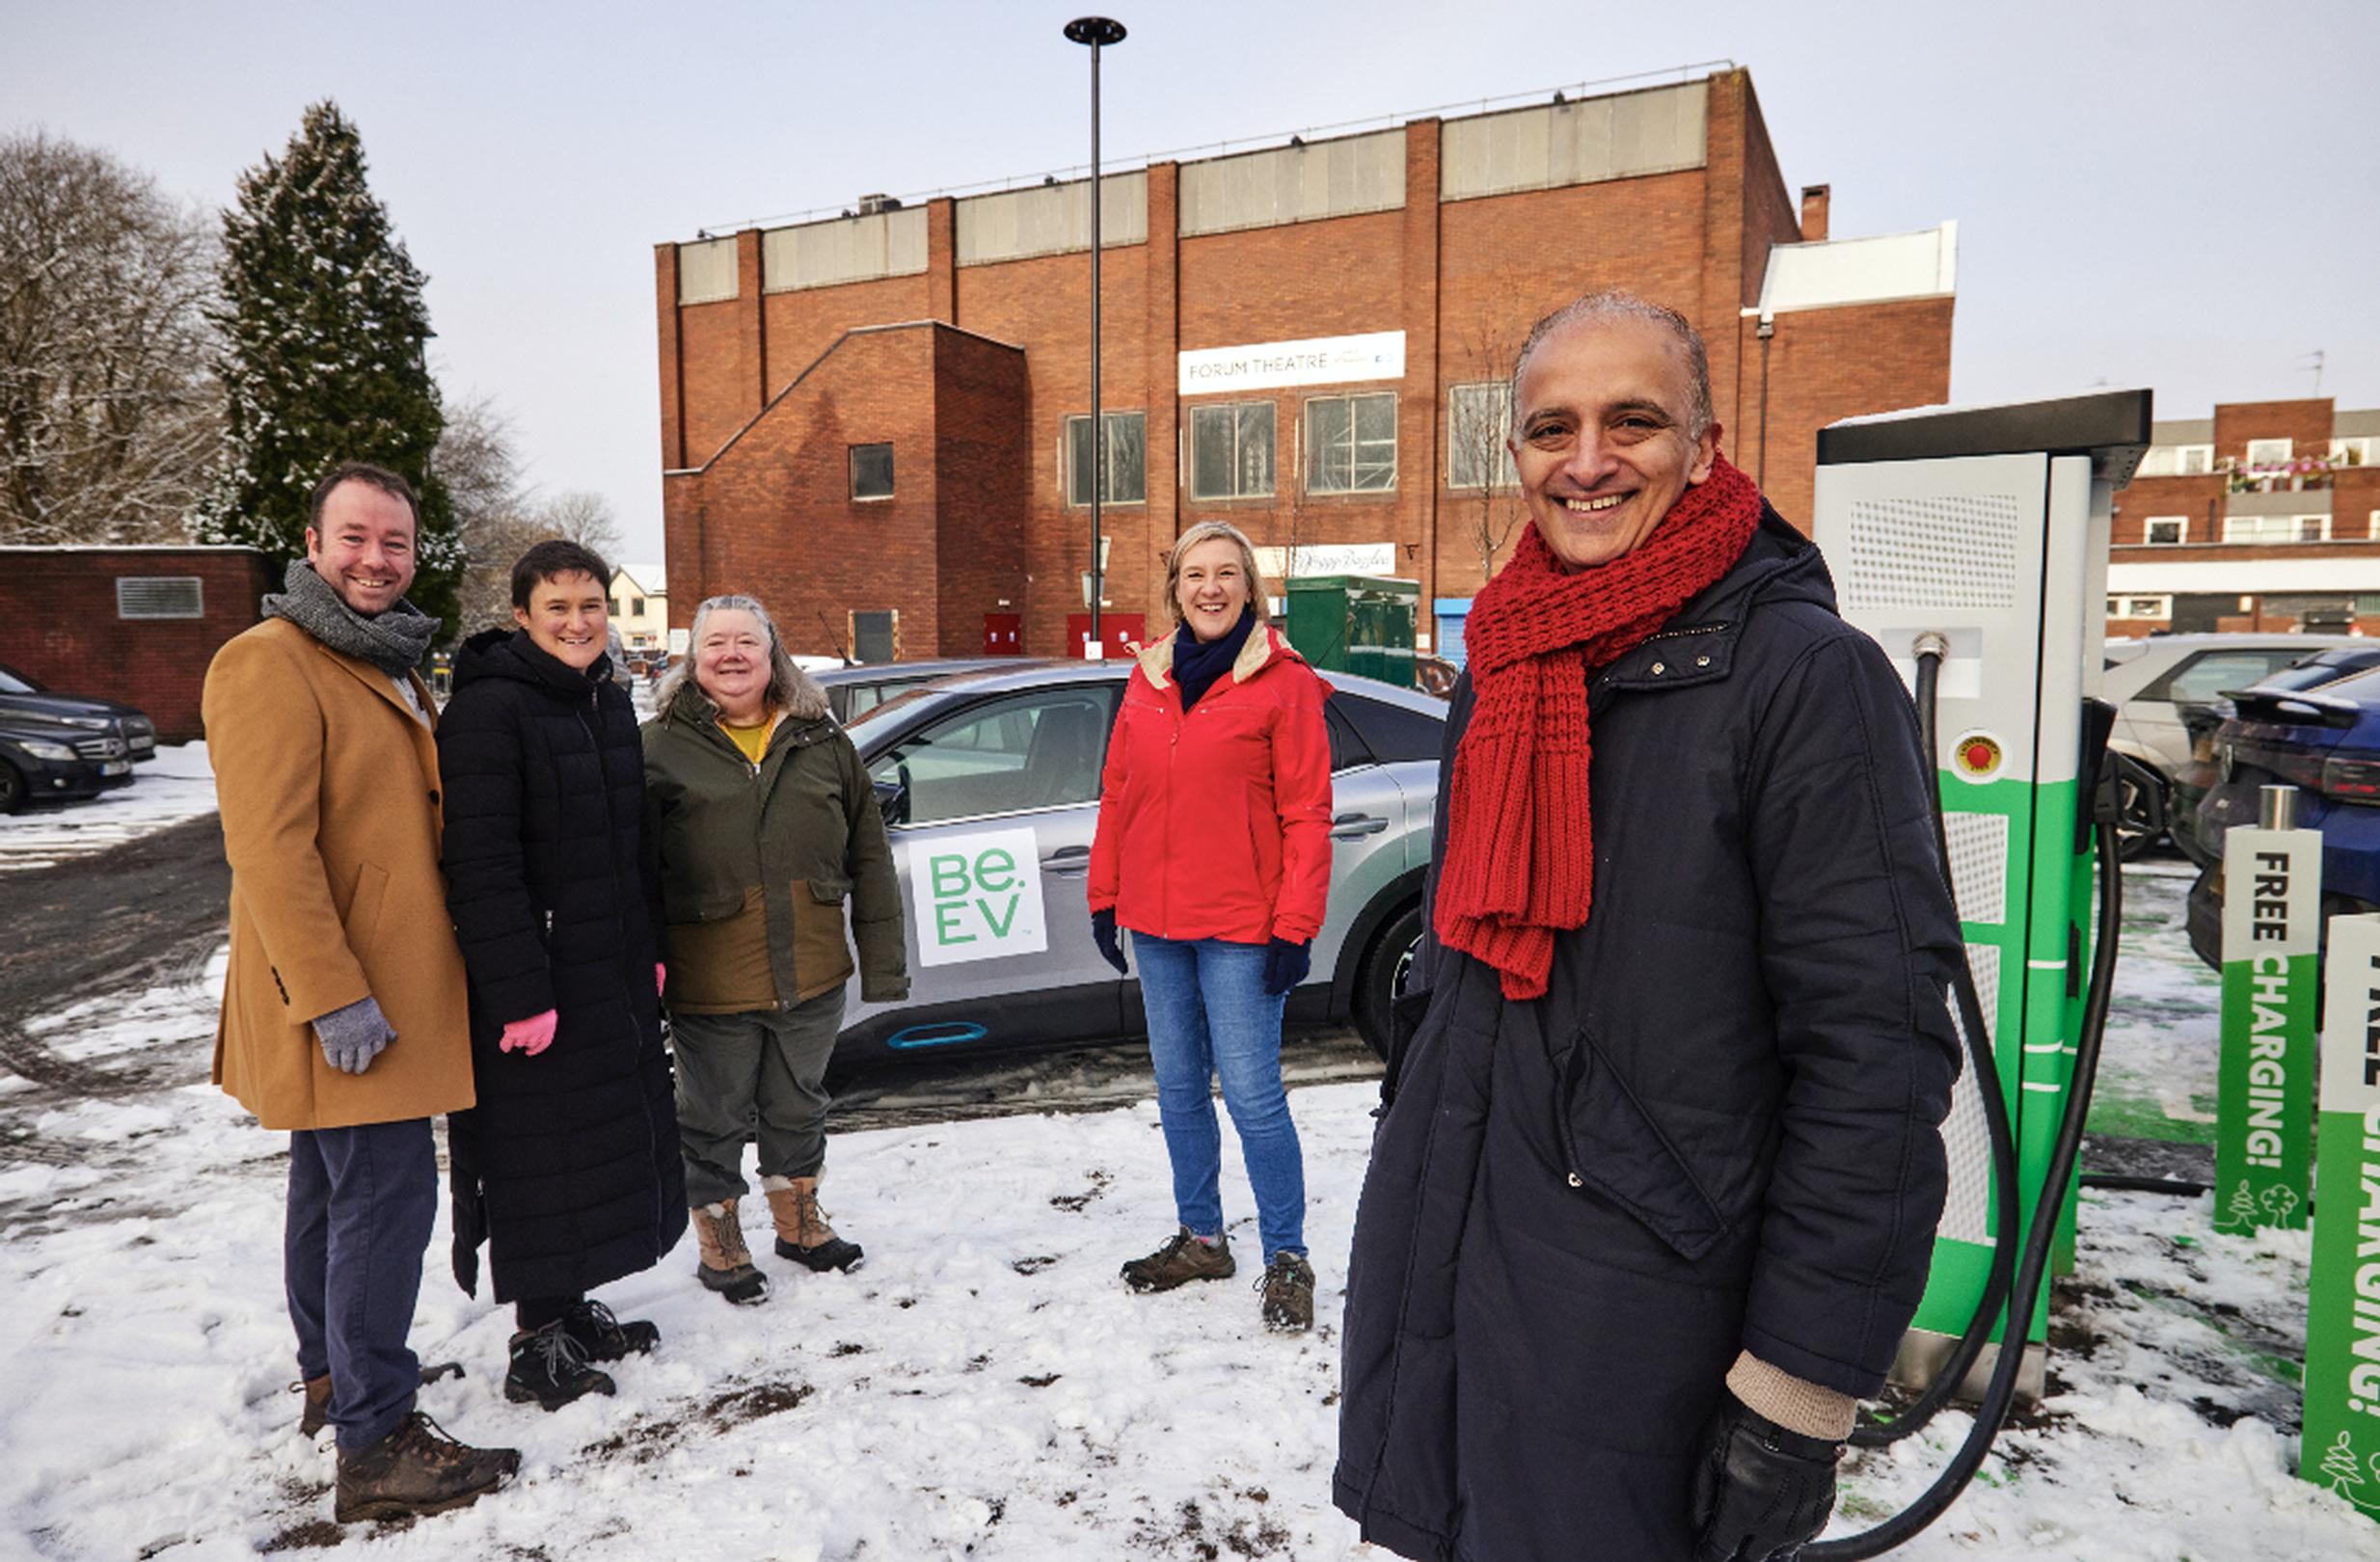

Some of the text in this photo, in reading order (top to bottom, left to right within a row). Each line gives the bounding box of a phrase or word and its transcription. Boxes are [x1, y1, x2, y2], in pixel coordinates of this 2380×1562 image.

[1189, 361, 1248, 380] FORUM
[1253, 352, 1328, 374] THEATRE
[934, 893, 1020, 946] EV
[2245, 852, 2289, 1169] FREE CHARGING!
